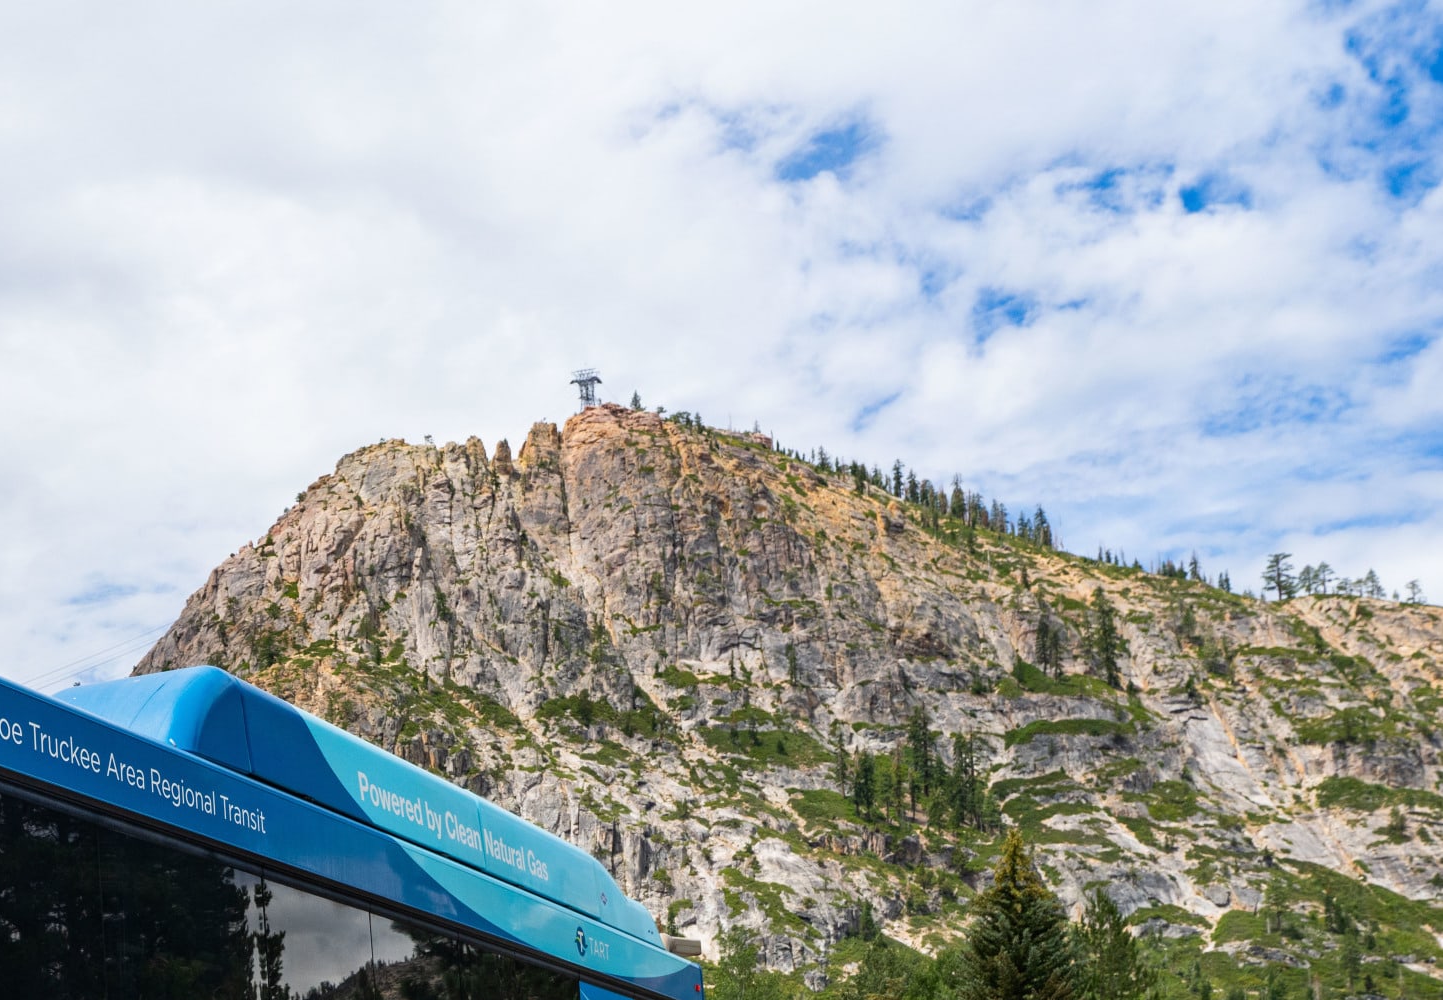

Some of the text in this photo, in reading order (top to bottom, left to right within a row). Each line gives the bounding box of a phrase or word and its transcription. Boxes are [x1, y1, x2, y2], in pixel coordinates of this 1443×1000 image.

[28, 722, 101, 774] Truckee
[106, 752, 146, 791] Area
[150, 767, 217, 817] Regional
[219, 795, 267, 835] Transit
[357, 771, 549, 881] Powered by Clean Natural Gas
[588, 937, 610, 960] TART
